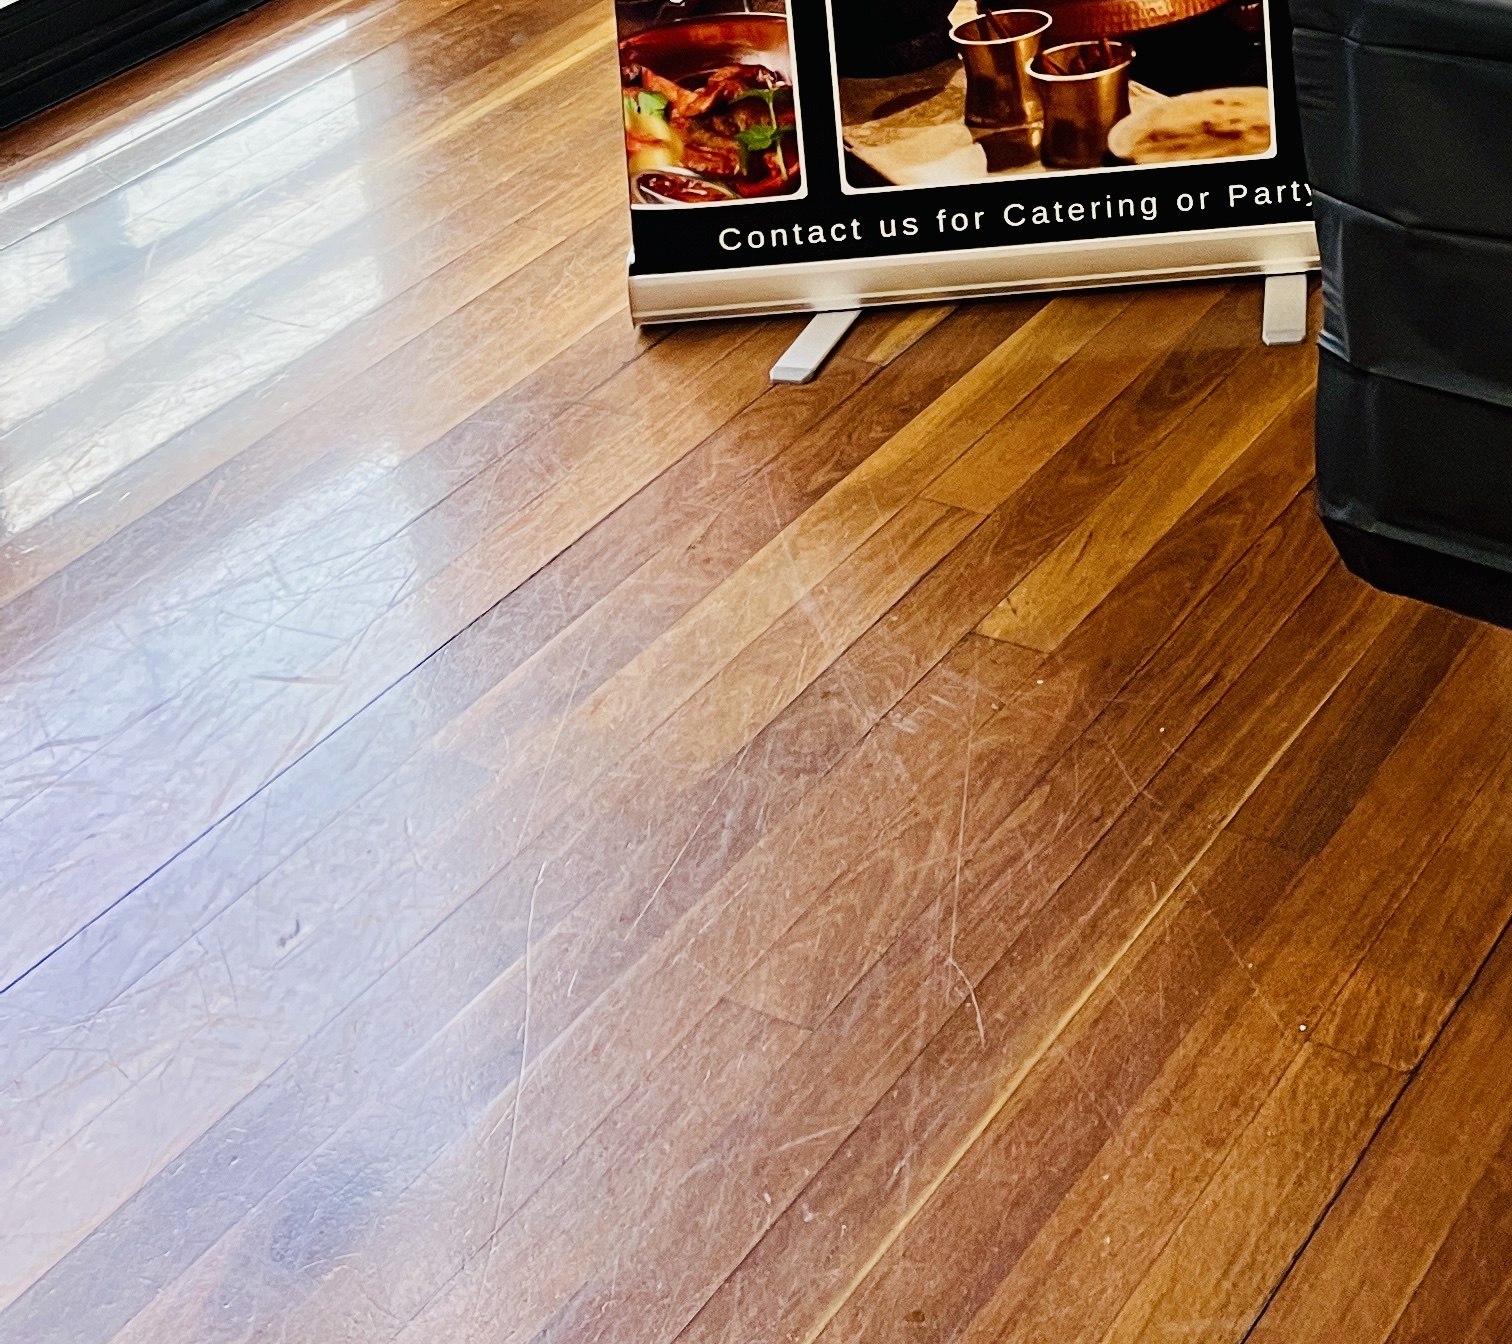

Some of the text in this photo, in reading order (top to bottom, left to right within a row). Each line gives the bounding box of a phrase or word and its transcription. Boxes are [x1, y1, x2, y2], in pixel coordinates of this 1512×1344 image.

[718, 218, 862, 251] Contact
[879, 217, 919, 238] us
[935, 208, 985, 233] for
[1003, 194, 1158, 227] Catering
[1176, 191, 1210, 212] or
